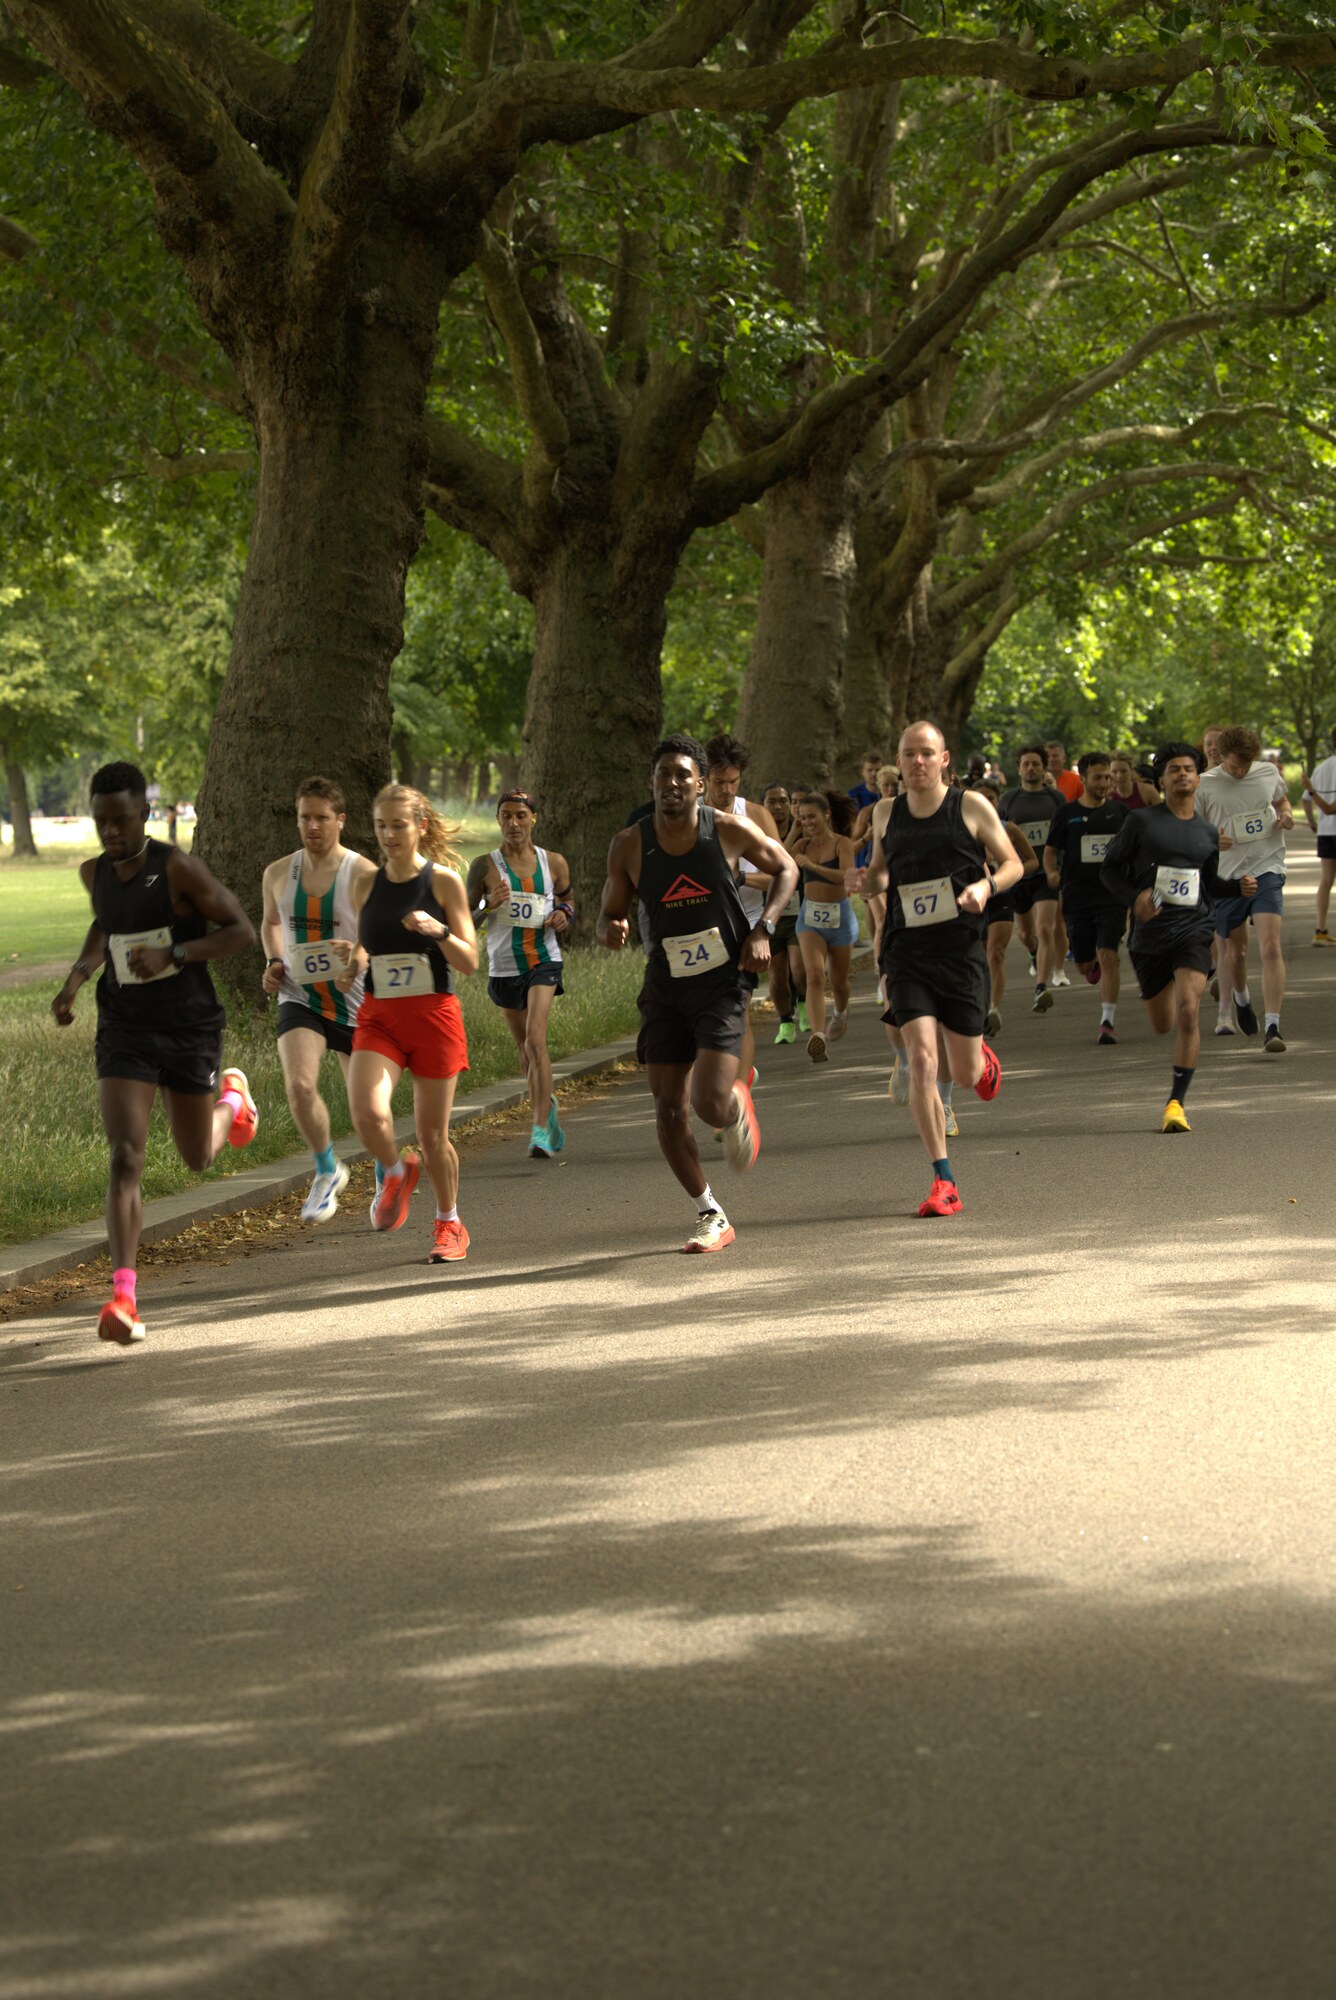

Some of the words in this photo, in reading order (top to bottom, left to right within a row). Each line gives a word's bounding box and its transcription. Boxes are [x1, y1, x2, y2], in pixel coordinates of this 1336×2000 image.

[1027, 829, 1042, 840] 41
[1245, 819, 1264, 834] 63
[1091, 843, 1108, 856] 53
[1168, 880, 1189, 896] 36
[509, 902, 532, 919] 30
[665, 901, 683, 910] NIKE
[686, 897, 709, 907] TRAIL
[913, 894, 938, 915] 67
[813, 911, 830, 923] 52
[679, 943, 710, 966] 24
[304, 954, 330, 973] 65
[387, 966, 414, 987] 27
